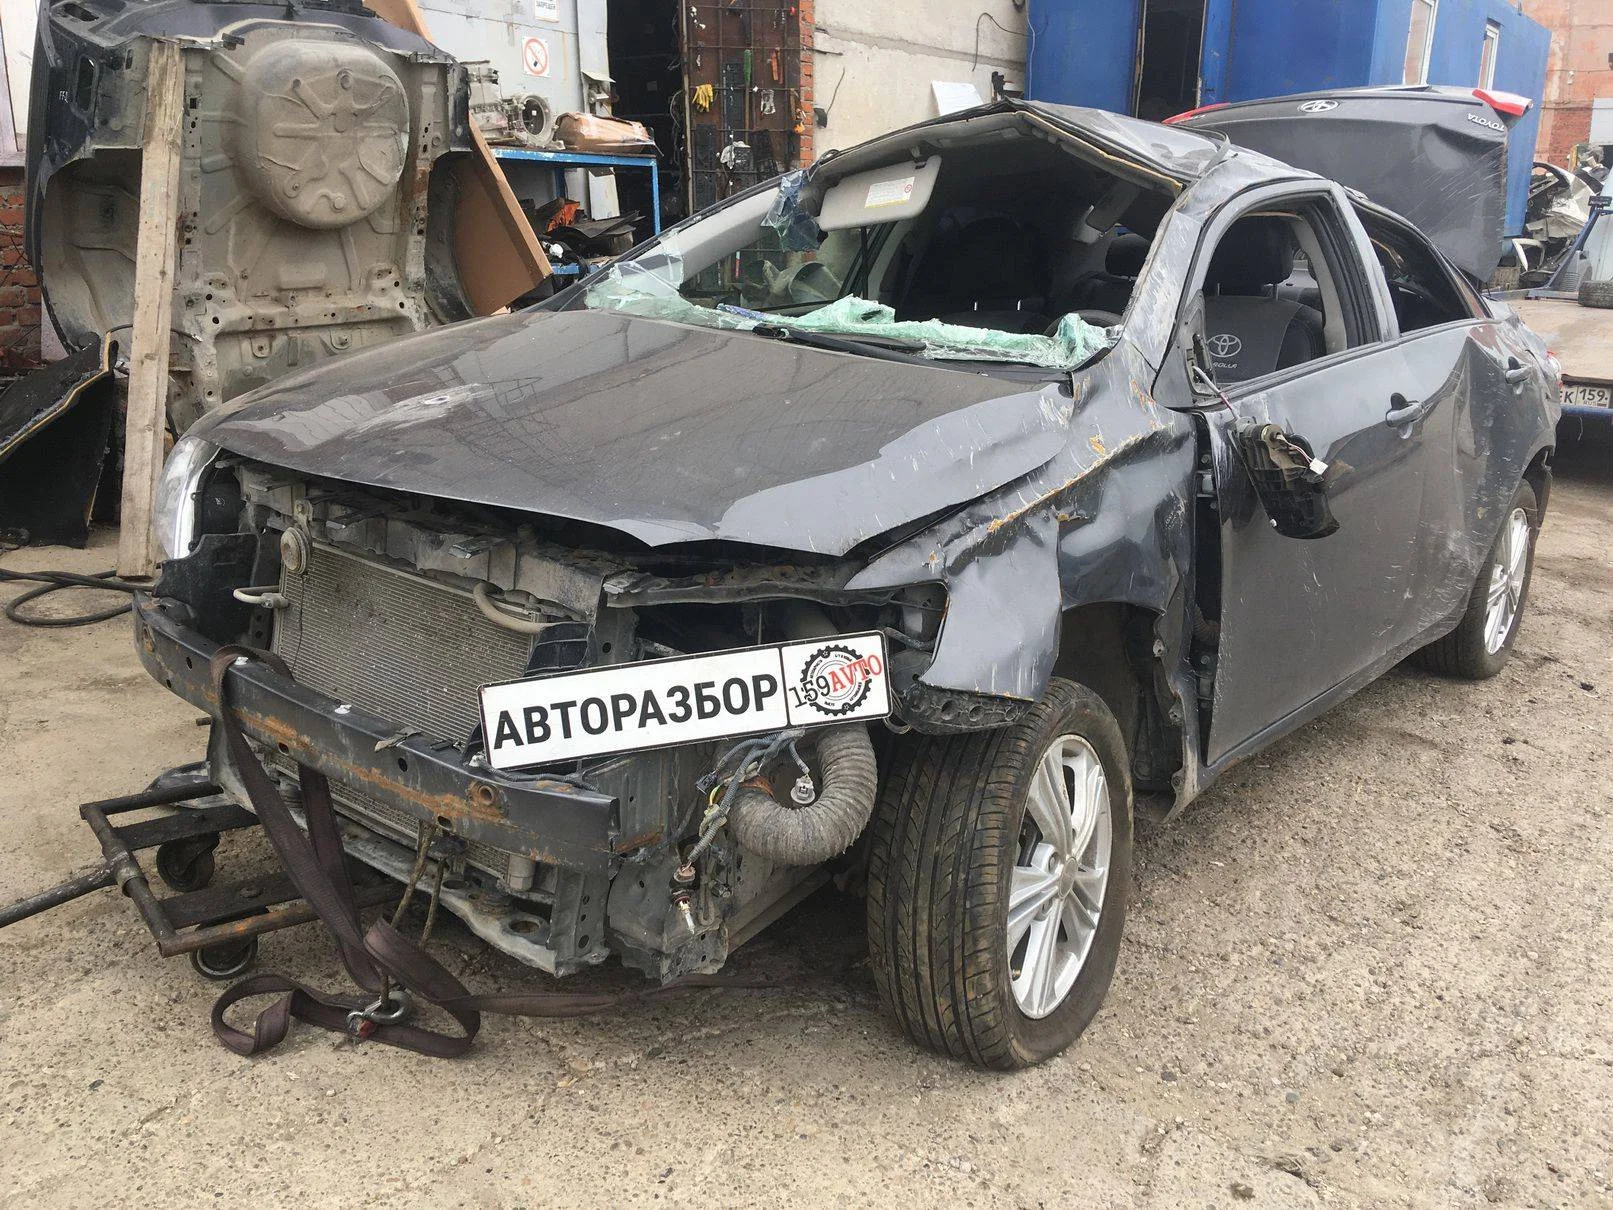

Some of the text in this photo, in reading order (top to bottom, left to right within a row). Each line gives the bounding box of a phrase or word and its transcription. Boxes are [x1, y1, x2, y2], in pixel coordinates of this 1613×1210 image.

[1467, 112, 1505, 133] TOYOTA
[1212, 361, 1238, 369] ROLLA
[1579, 388, 1605, 402] 159
[493, 673, 779, 750] АВТОРАЗБОР
